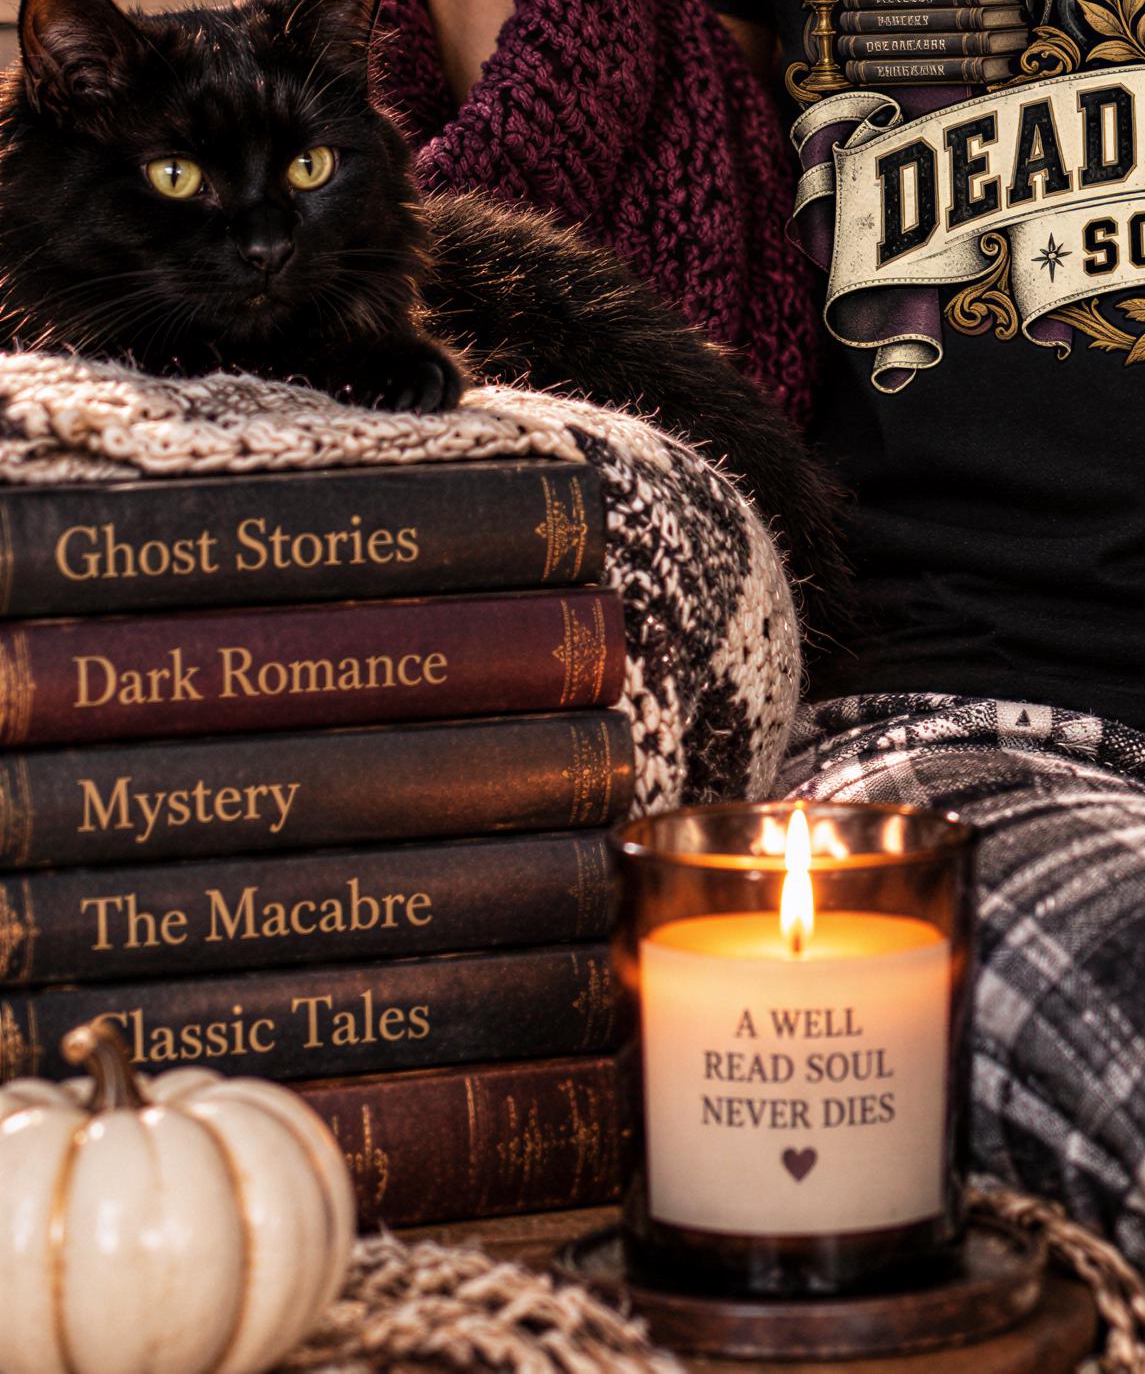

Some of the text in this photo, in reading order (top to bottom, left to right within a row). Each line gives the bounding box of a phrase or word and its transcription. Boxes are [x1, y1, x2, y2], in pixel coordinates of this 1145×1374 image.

[876, 81, 1138, 269] DEAD
[55, 515, 419, 580] Ghost Stories
[73, 647, 448, 708] Dark Romance
[77, 776, 301, 842] Mystery
[80, 877, 432, 950] The Macabre
[290, 988, 430, 1049] Tales
[734, 1006, 865, 1041] A WELL
[703, 1047, 896, 1085] READ SOUL
[701, 1091, 897, 1130] NEVER DIES
